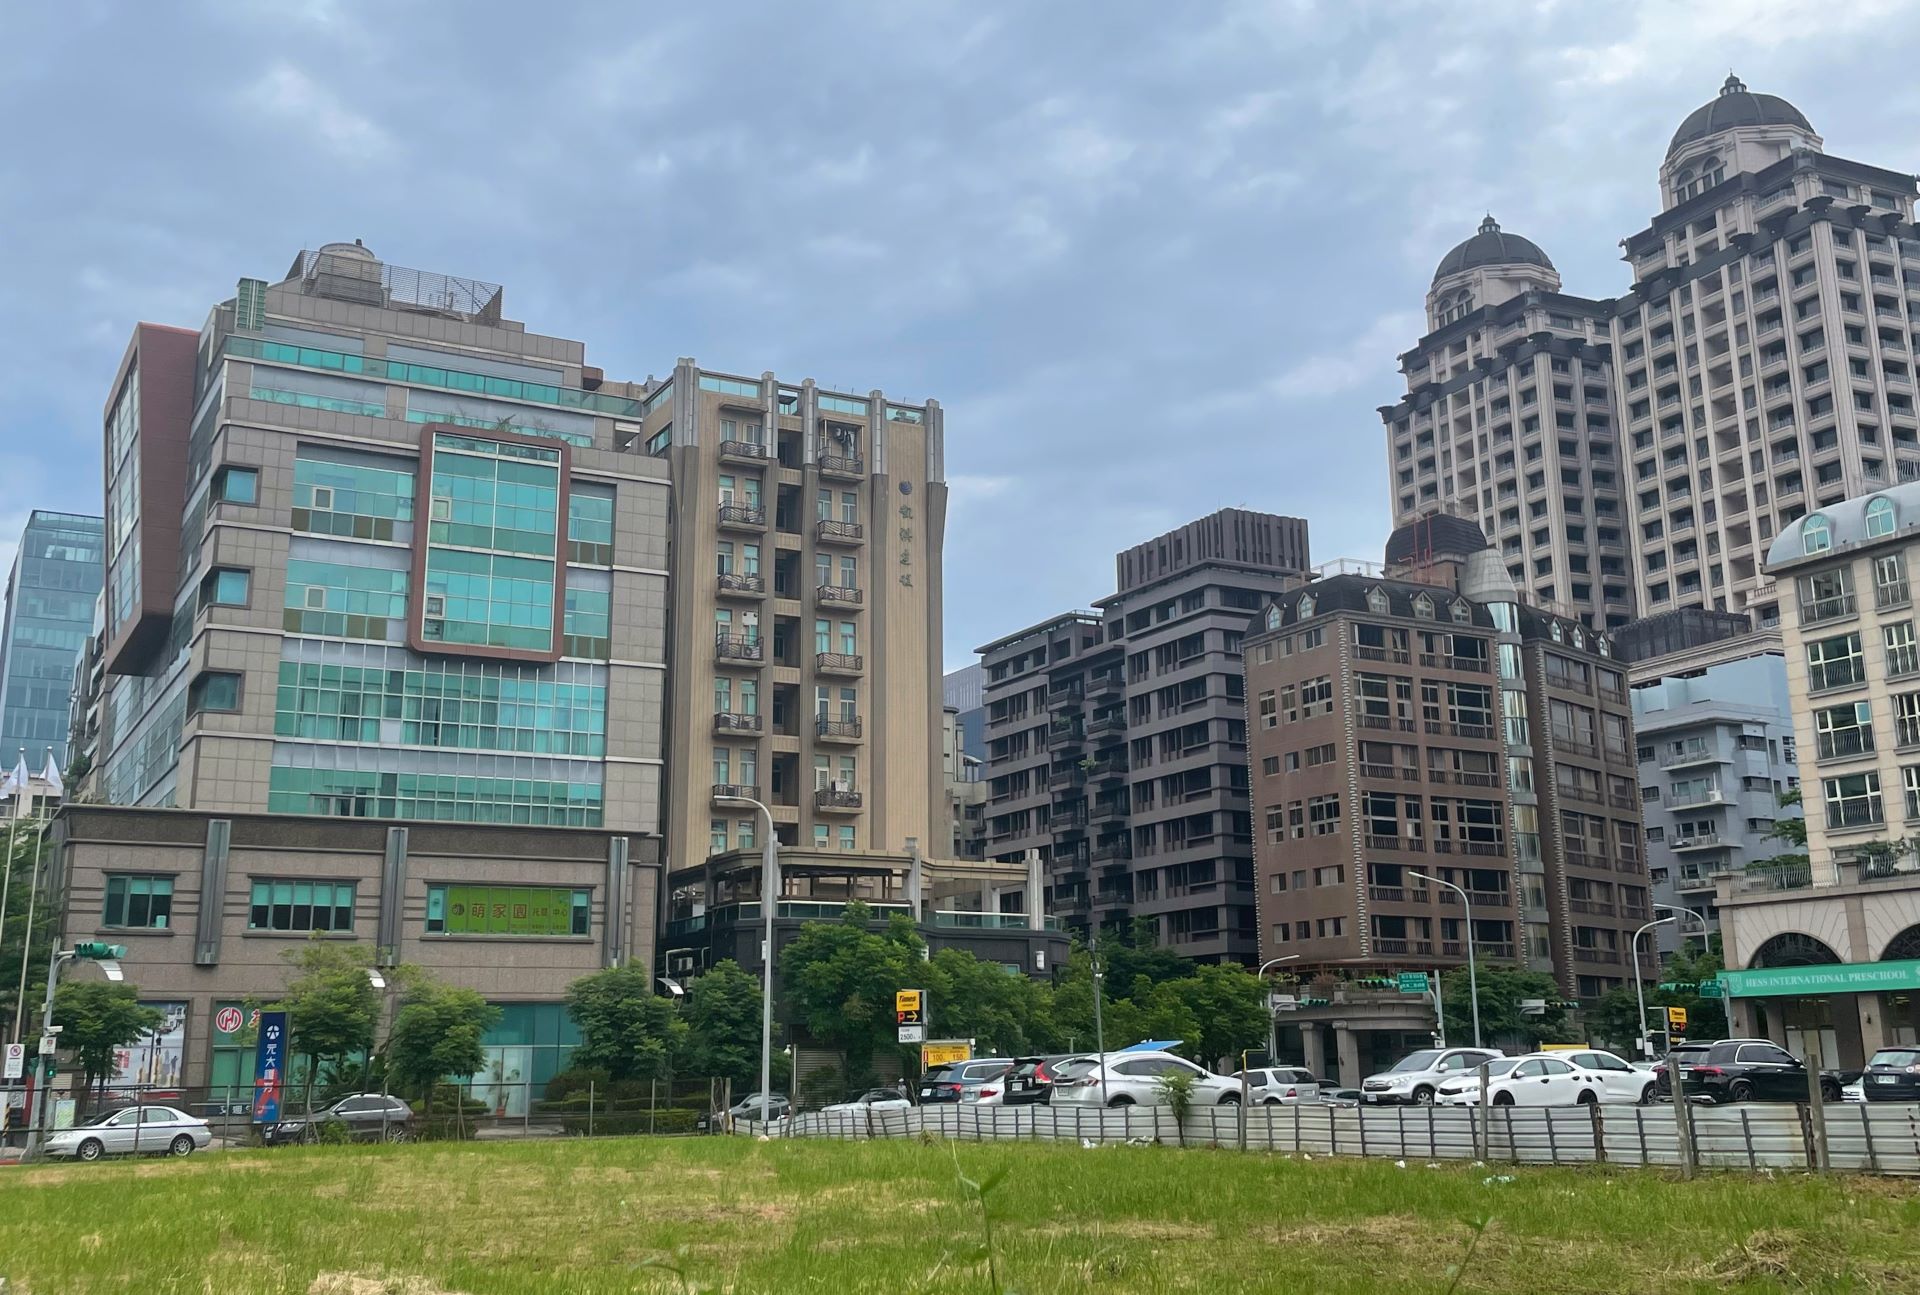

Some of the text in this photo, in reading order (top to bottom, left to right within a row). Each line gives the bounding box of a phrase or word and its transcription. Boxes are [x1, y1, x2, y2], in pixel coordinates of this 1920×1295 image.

[472, 903, 527, 919] 萌家園
[1745, 977, 1768, 988] HESS
[1770, 972, 1847, 986] INTERNATIONAL
[1849, 969, 1908, 982] PRESCHOOL
[898, 1012, 905, 1023] P
[932, 1053, 944, 1061] 100
